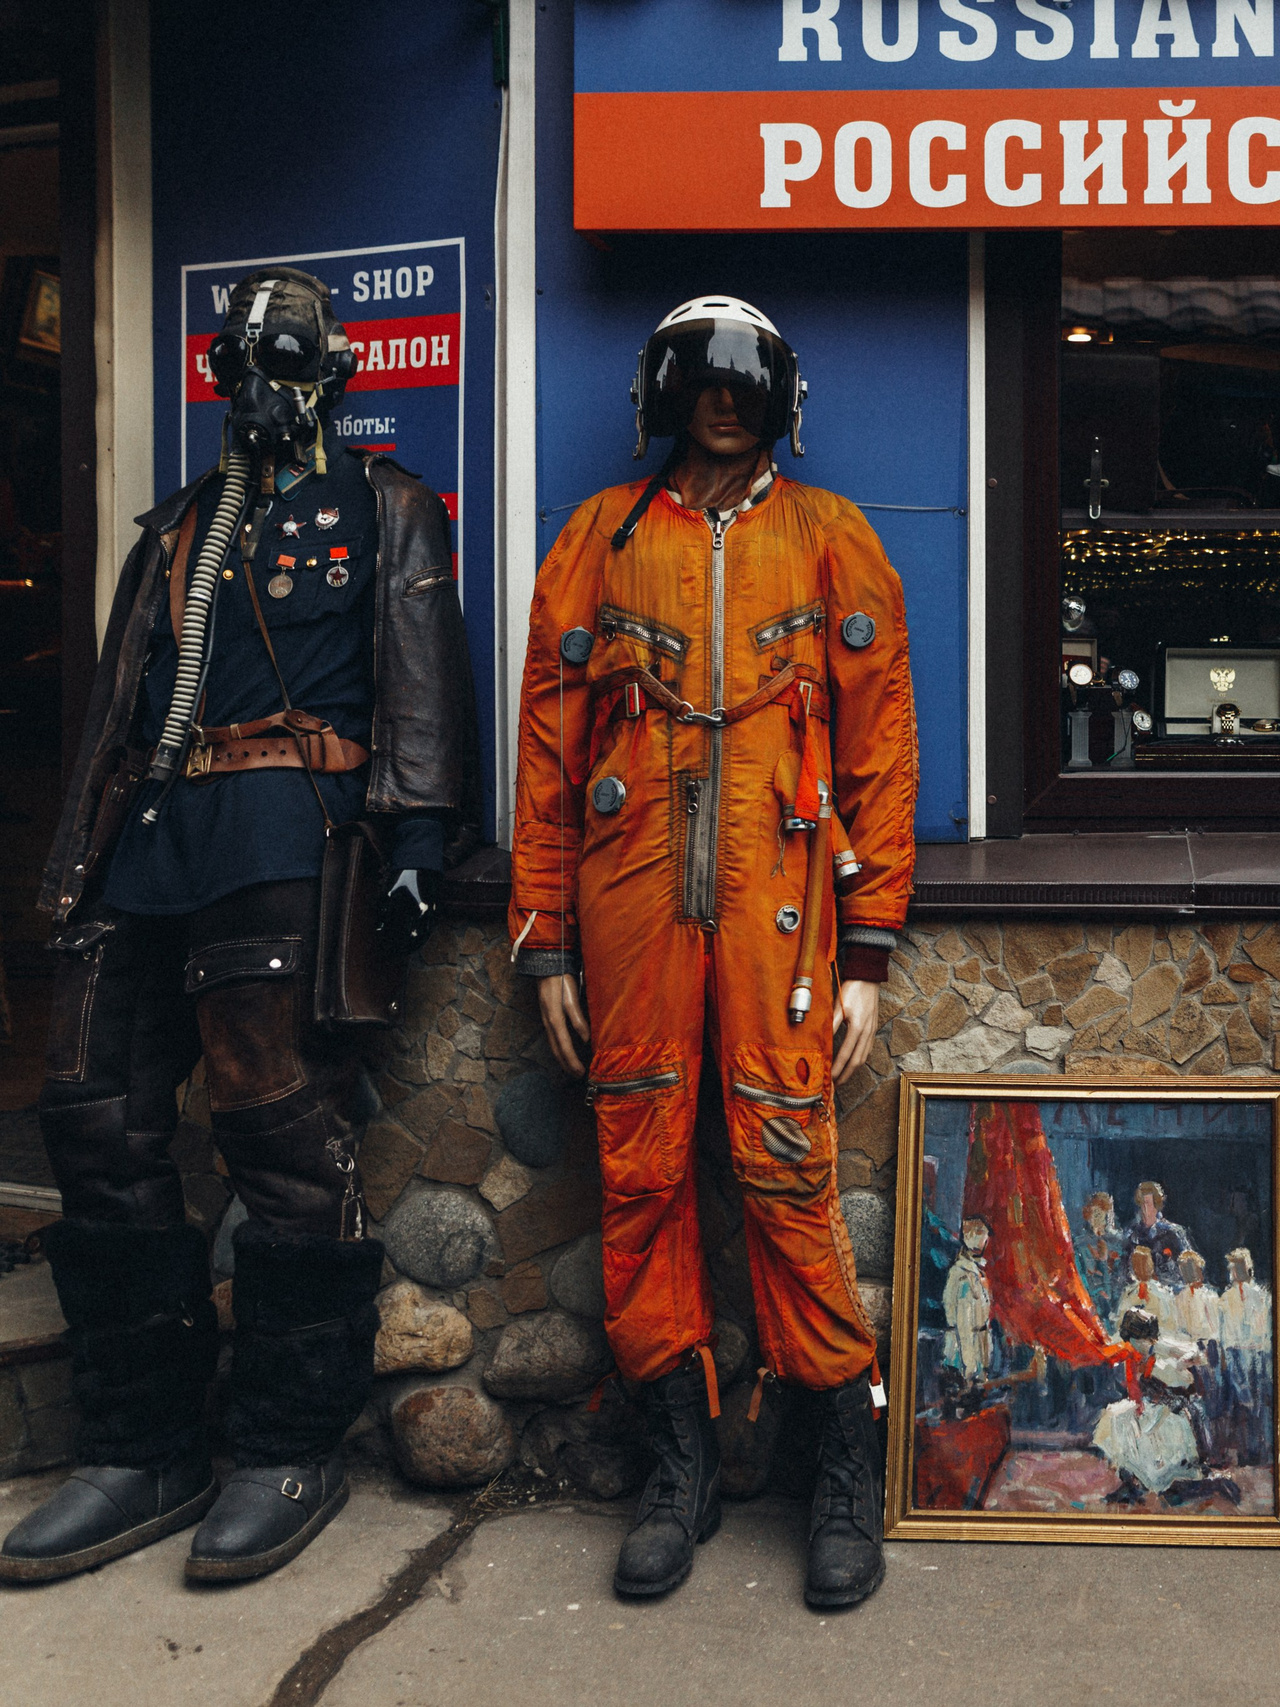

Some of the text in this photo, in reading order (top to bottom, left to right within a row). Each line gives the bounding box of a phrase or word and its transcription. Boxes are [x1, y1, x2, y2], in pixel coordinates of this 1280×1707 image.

[778, 0, 1275, 62] RUSSIAN
[353, 264, 434, 302] SHOP
[334, 414, 396, 436] аботы:
